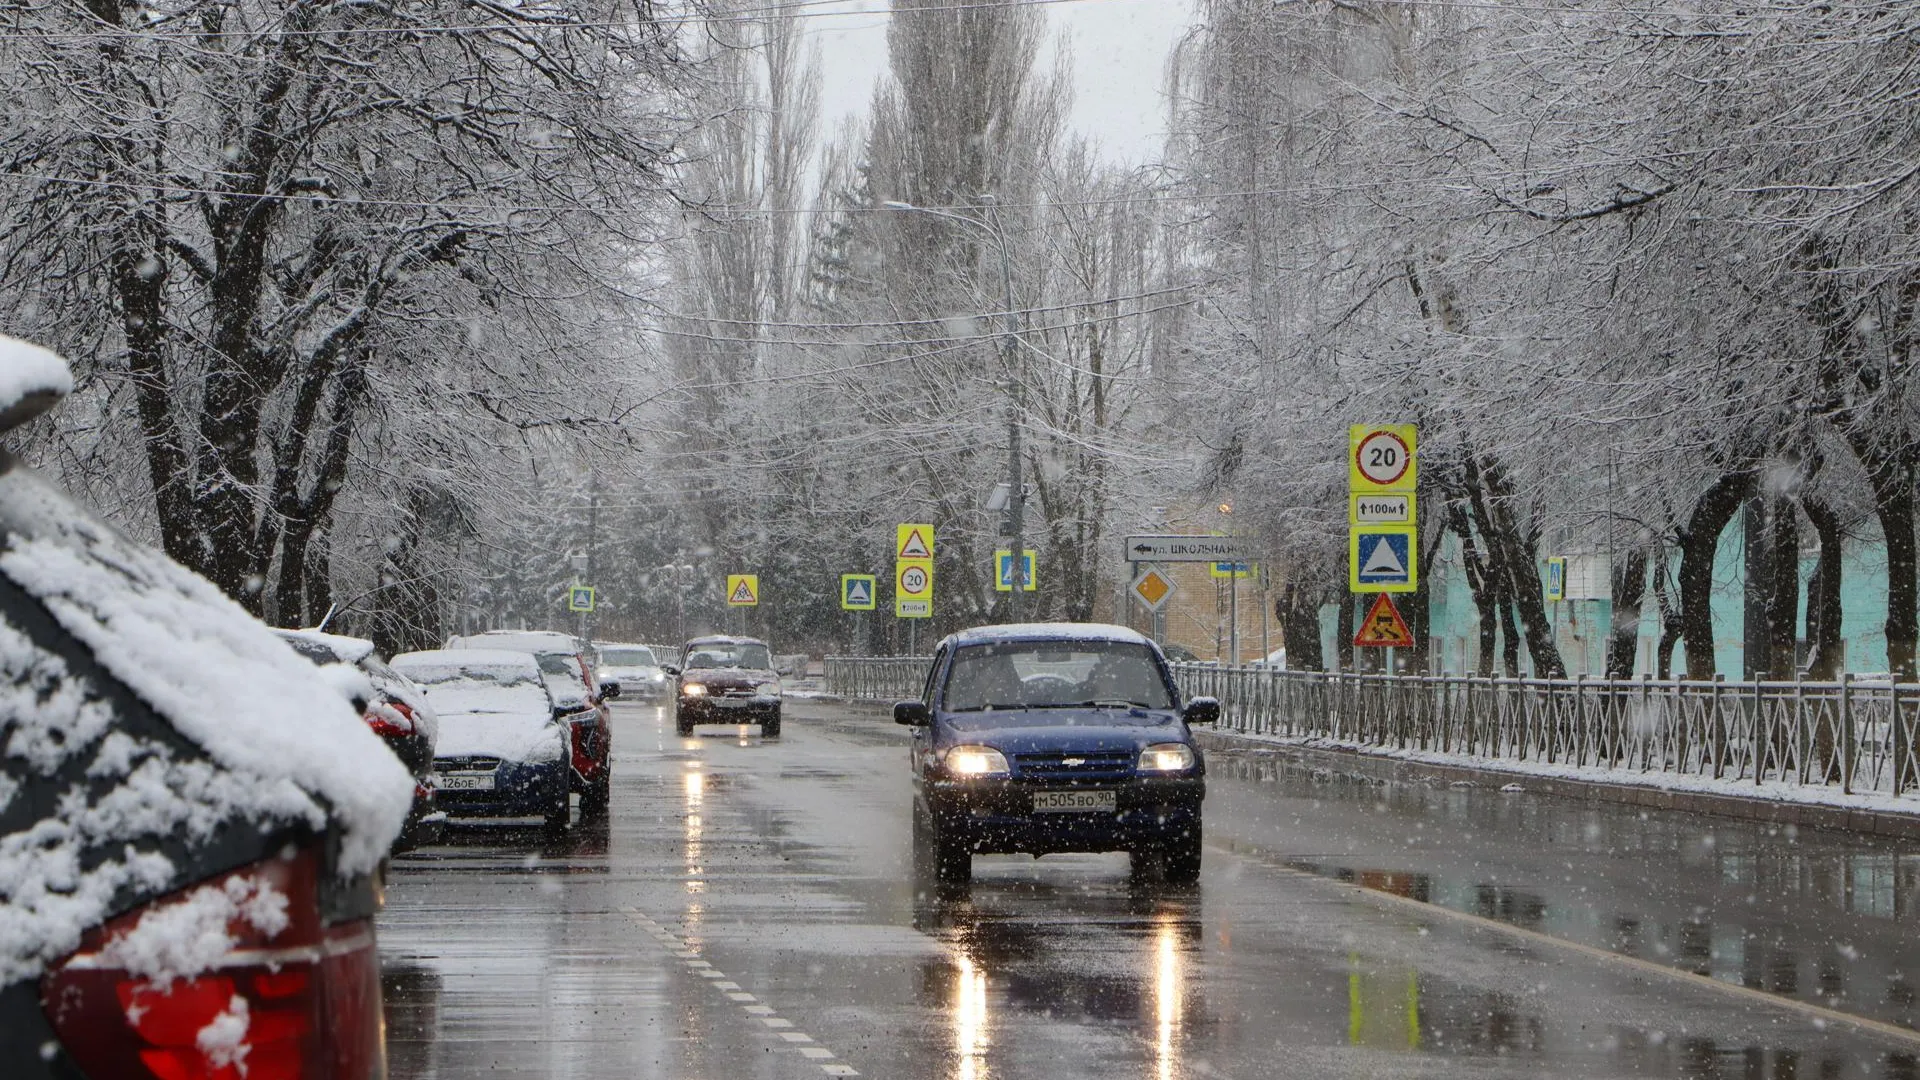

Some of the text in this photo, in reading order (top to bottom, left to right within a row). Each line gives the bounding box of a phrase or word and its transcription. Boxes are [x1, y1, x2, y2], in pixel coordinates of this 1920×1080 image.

[1370, 447, 1396, 467] 20
[1368, 503, 1397, 514] 100м
[907, 574, 922, 586] 20
